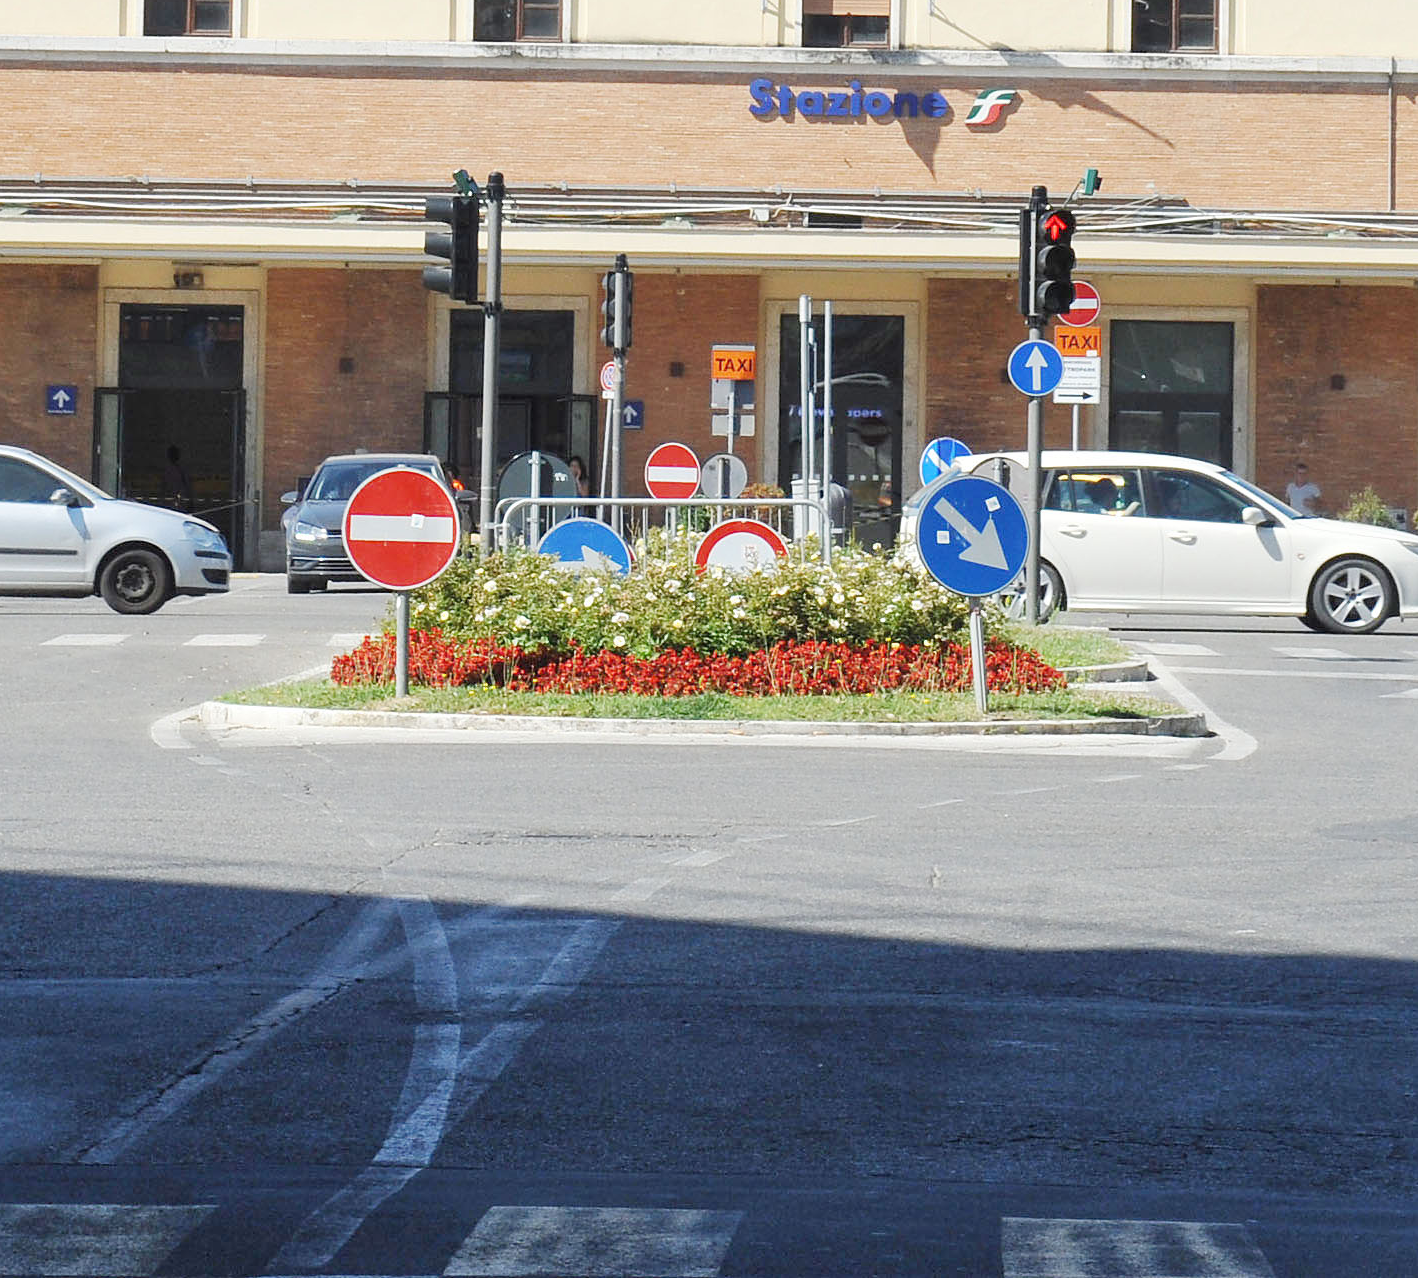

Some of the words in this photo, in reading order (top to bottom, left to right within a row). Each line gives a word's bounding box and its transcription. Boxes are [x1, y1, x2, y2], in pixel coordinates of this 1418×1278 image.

[750, 79, 948, 117] Stazione
[1058, 335, 1098, 350] TAXI
[715, 358, 753, 372] TAXI
